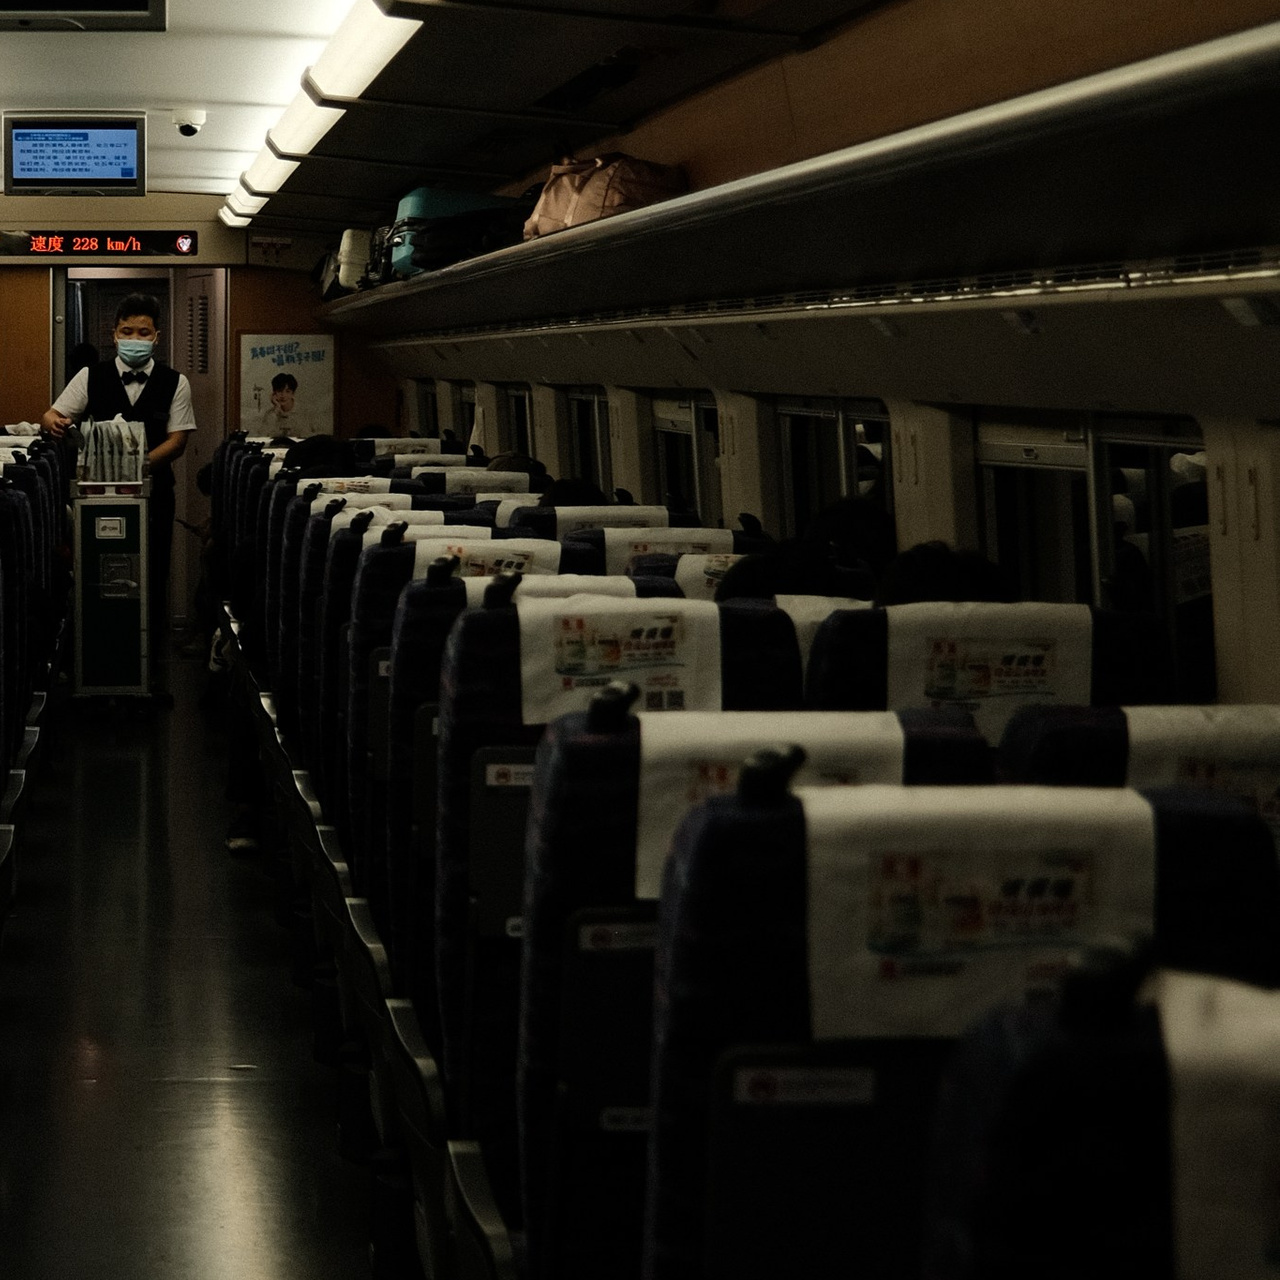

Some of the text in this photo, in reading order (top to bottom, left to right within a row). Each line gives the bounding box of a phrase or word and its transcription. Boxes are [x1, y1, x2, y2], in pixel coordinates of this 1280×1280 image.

[30, 236, 141, 252] 速度 228 km/h
